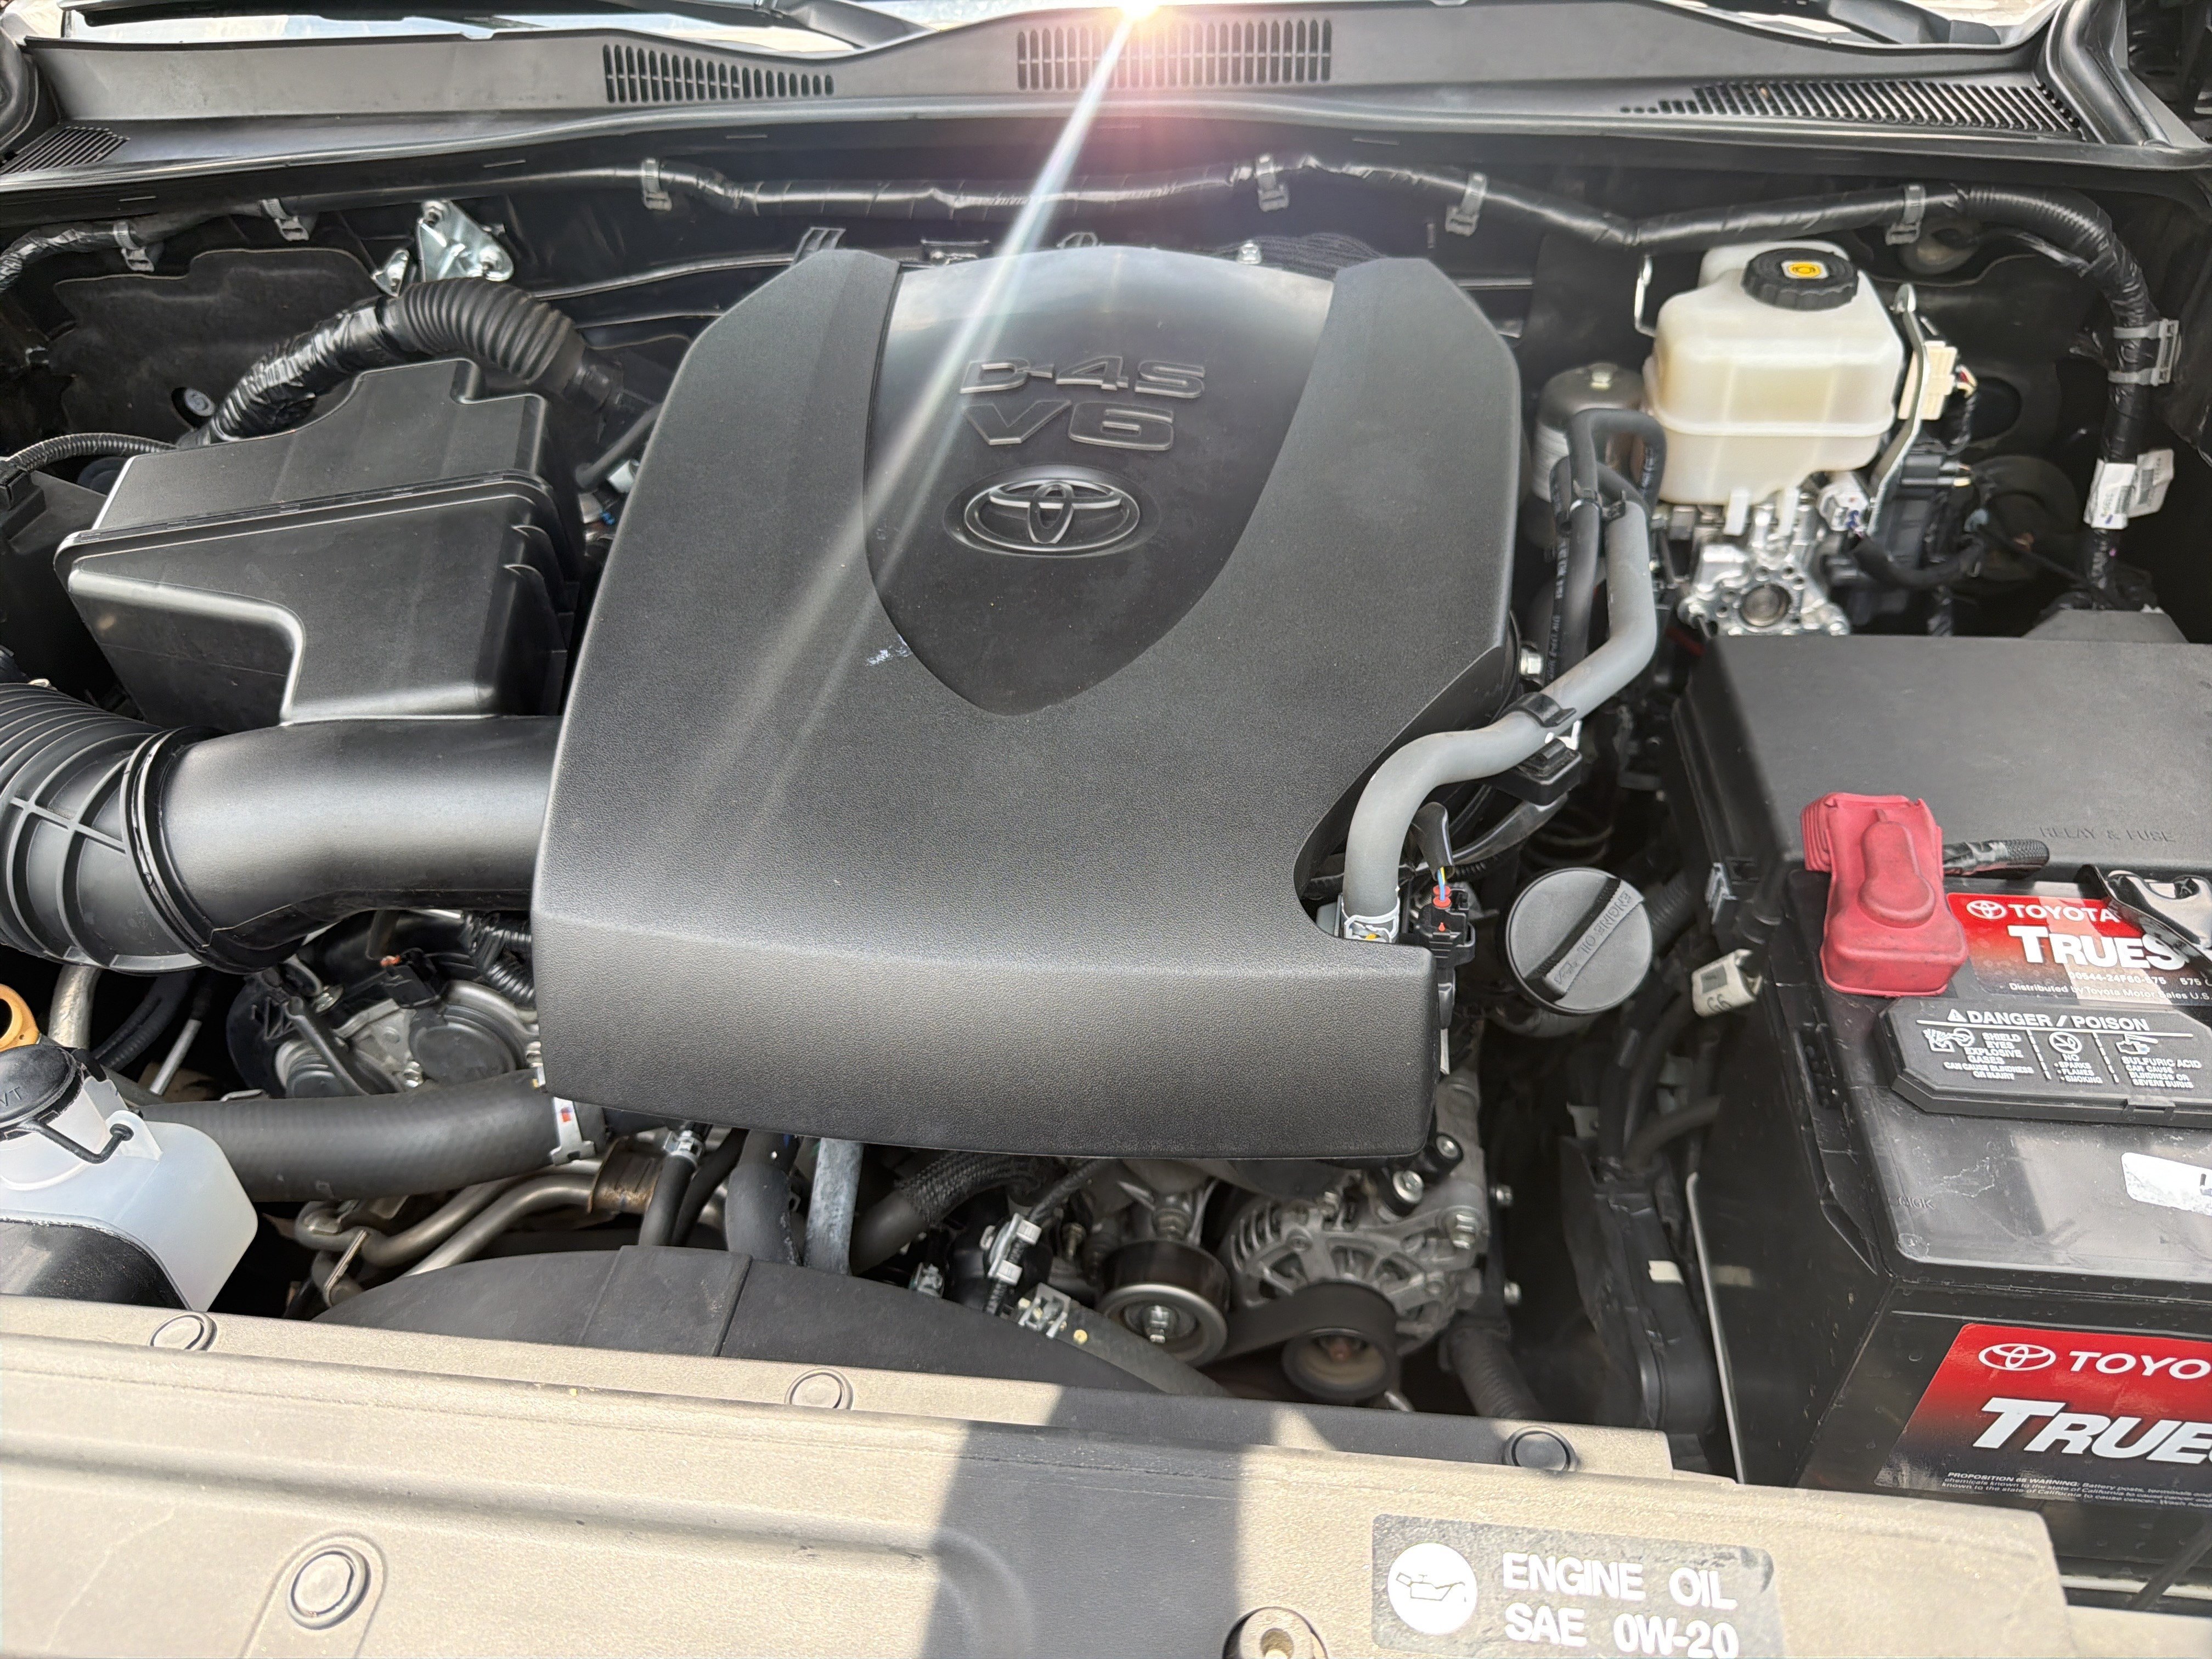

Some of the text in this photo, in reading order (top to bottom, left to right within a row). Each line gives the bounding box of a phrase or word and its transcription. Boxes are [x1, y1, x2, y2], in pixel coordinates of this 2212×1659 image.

[960, 355, 1206, 398] D-4S
[961, 399, 1175, 452] V6
[1577, 890, 1632, 955] ENGINE OIL
[2008, 904, 2122, 923] TOYOTA
[2007, 925, 2191, 970] TRUES
[2008, 983, 2068, 994] Distributed
[2084, 986, 2120, 996] Toyota
[2122, 989, 2155, 998] Motor
[2157, 990, 2188, 999] Sales
[1967, 1011, 2053, 1027] DANGER
[2070, 1015, 2150, 1031] POISON
[1982, 1032, 2022, 1042] SHIELD
[1985, 1041, 2015, 1049] EYES
[1964, 1047, 2024, 1058] EXPLOSIVE
[2062, 1053, 2080, 1062] NO
[2121, 1056, 2202, 1069] SULFURIC ACID
[2068, 1351, 2212, 1380] TOYO
[1972, 1397, 2212, 1464] TRUE
[1948, 1472, 2015, 1482] PROPOSITION
[1503, 1551, 1739, 1610] ENGINE OIL
[1505, 1602, 1740, 1659] SAE 0W-20
